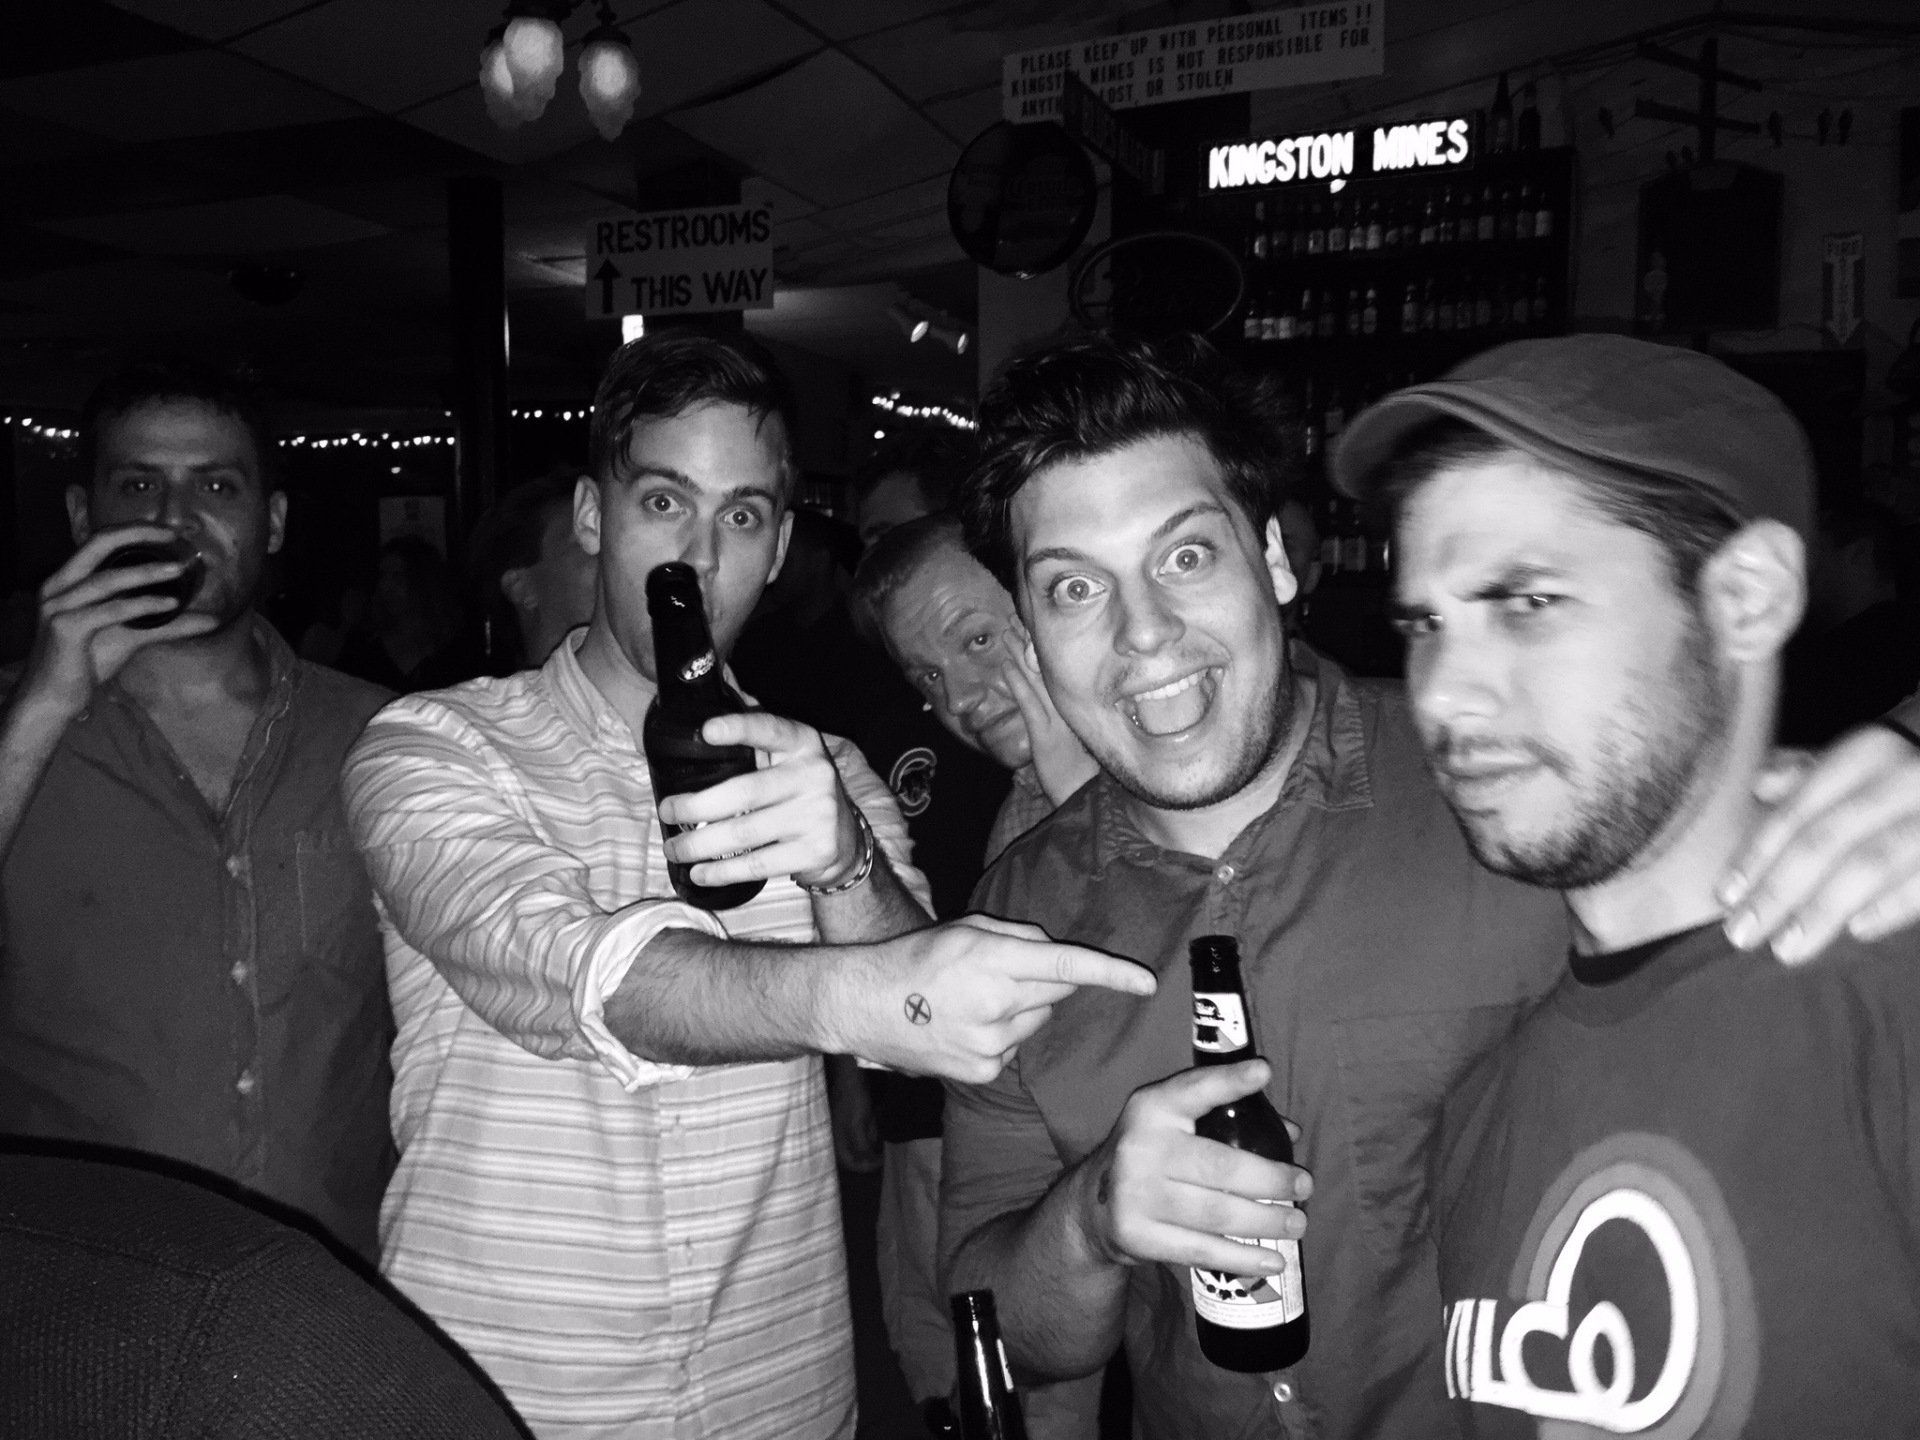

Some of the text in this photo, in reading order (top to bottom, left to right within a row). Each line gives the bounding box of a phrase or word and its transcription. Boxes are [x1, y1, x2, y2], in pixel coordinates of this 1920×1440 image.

[1011, 28, 1369, 97] KINGST MINES IS NOT RESPONSIBLE FOR
[1021, 48, 1072, 74] PLEASE
[1084, 42, 1118, 63] KEEP
[1130, 36, 1148, 56] UP
[1160, 29, 1196, 49] WITH
[1207, 18, 1282, 43] PERSONAL
[1301, 8, 1348, 31] ITEMS
[1147, 77, 1163, 96] OR
[1177, 68, 1233, 91] STOLEN
[1208, 131, 1355, 189] KINGSTON
[1372, 119, 1469, 172] MINES
[597, 209, 770, 255] RESTROOMS
[631, 268, 767, 309] THIS WAY
